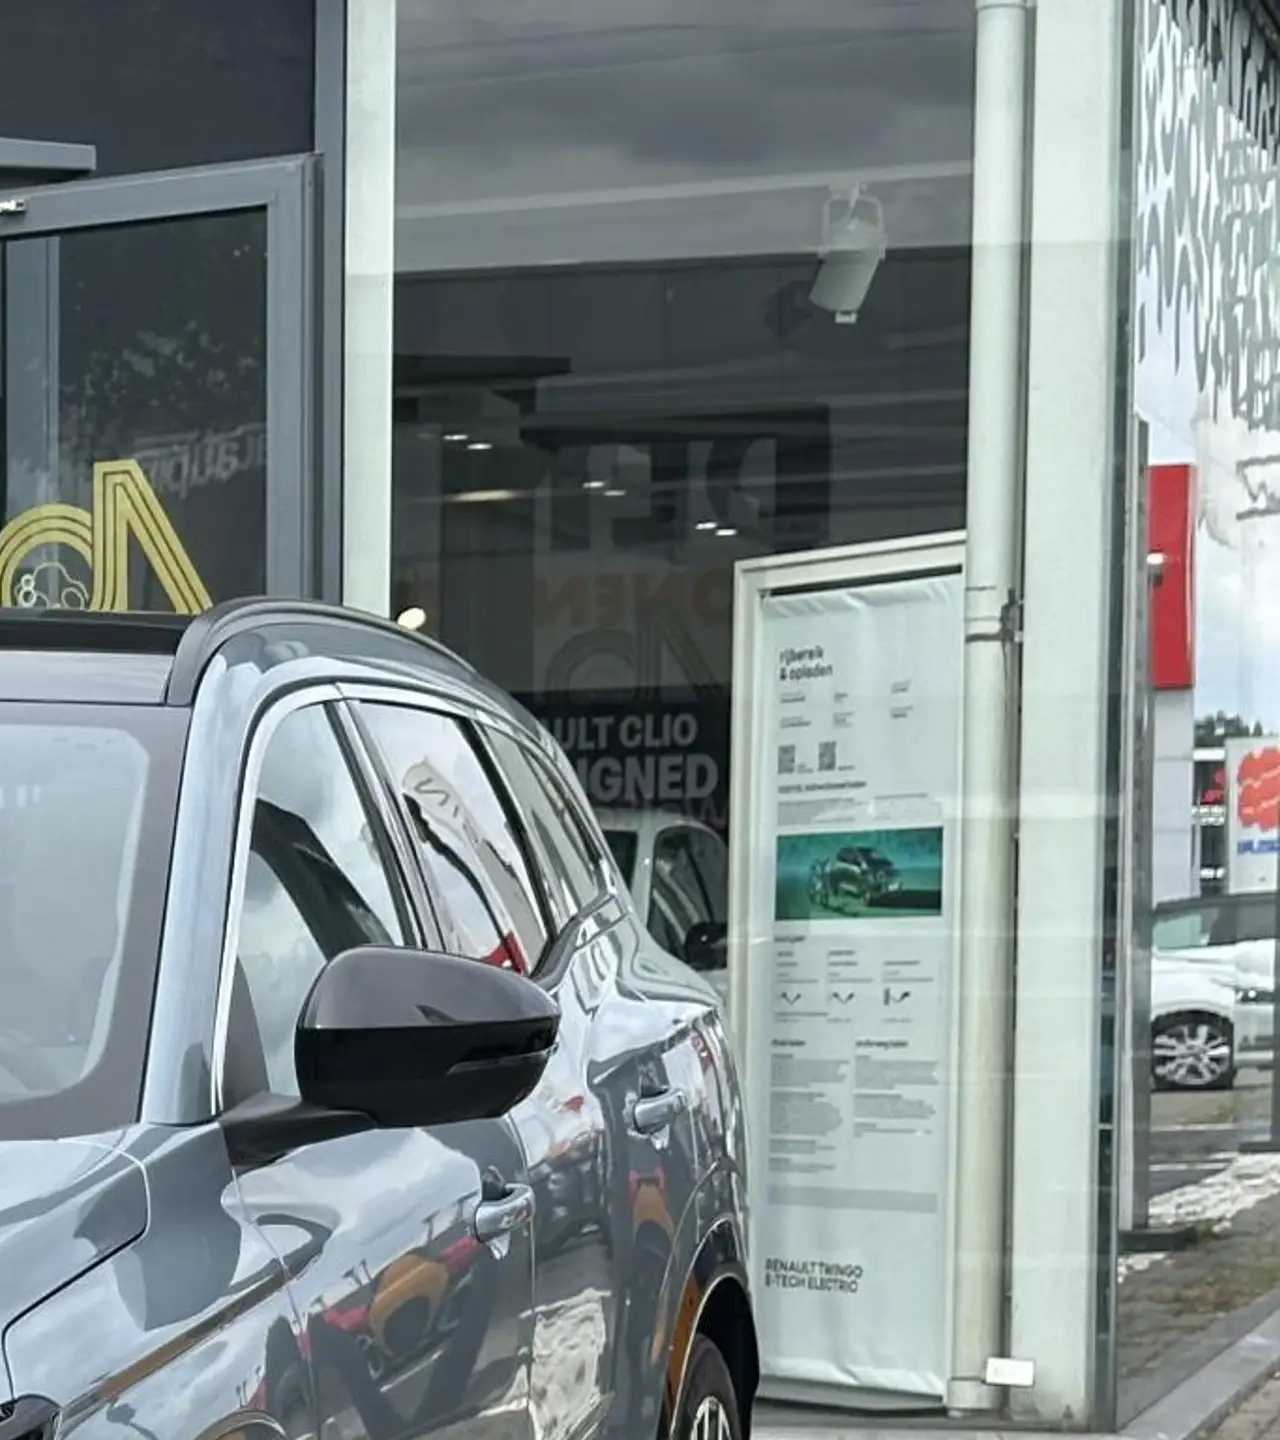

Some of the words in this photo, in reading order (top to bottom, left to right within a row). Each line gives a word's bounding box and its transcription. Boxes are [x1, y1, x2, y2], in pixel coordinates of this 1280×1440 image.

[539, 716, 615, 750] ULT
[618, 712, 698, 748] CLIO
[766, 1258, 816, 1274] RENAULT
[818, 1262, 862, 1277] TWINGO
[808, 1277, 857, 1293] ELECTRIC
